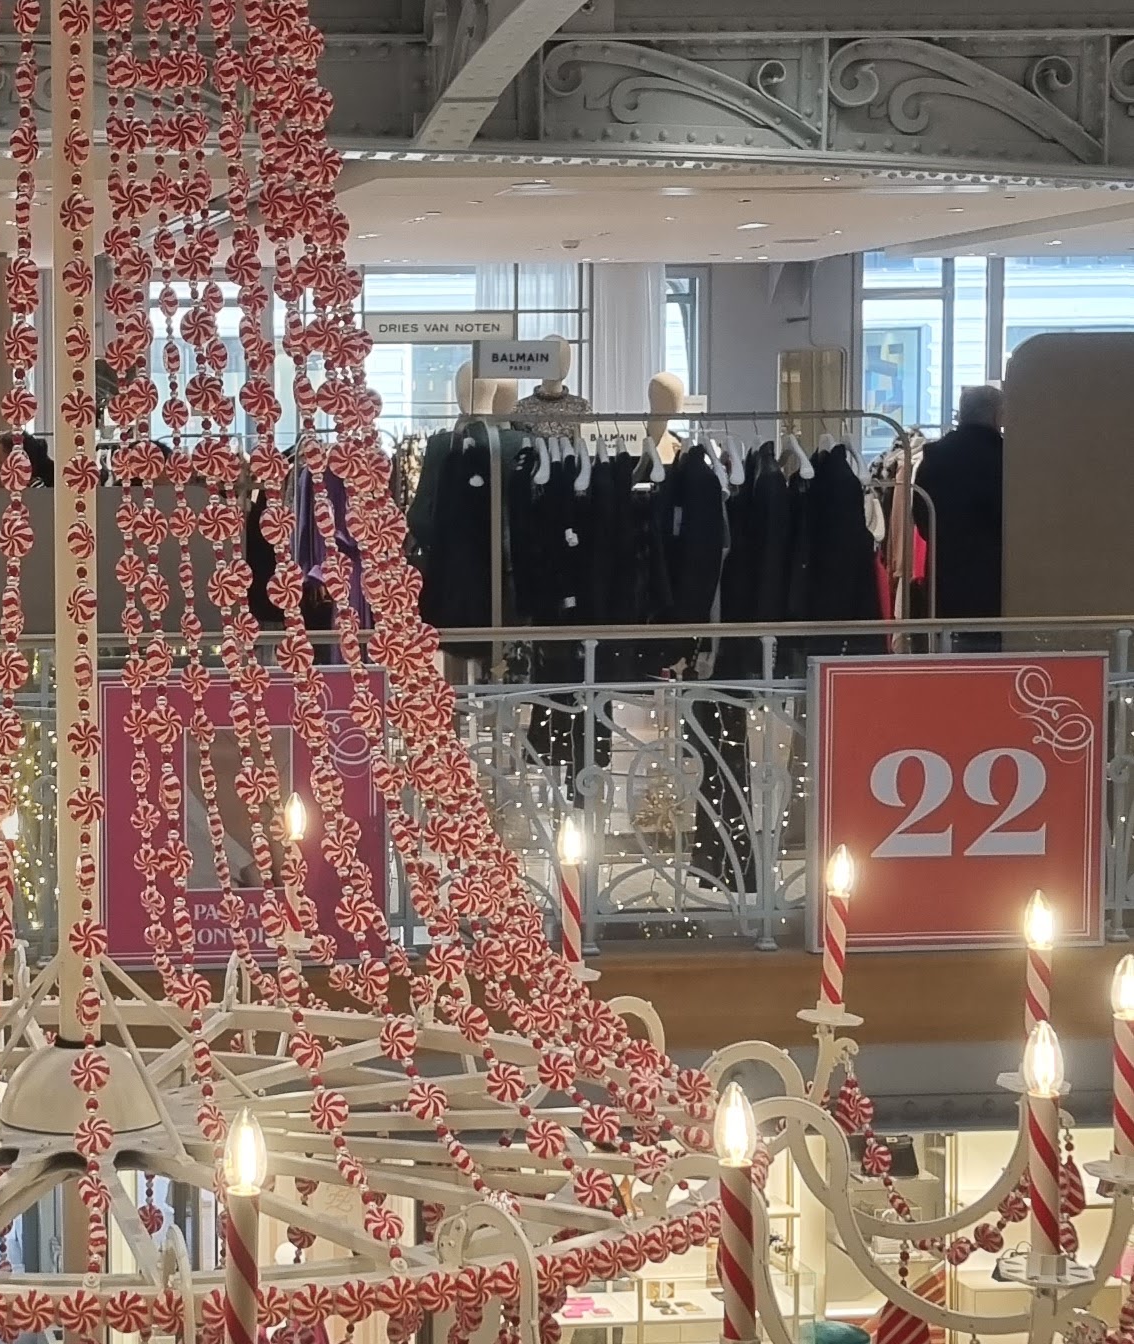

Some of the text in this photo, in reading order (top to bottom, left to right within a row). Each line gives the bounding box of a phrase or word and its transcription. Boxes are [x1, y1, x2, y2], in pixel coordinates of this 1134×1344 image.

[378, 323, 500, 333] DRIES VAN NOTEN
[491, 352, 550, 363] BALMAIN
[869, 747, 1047, 858] 22
